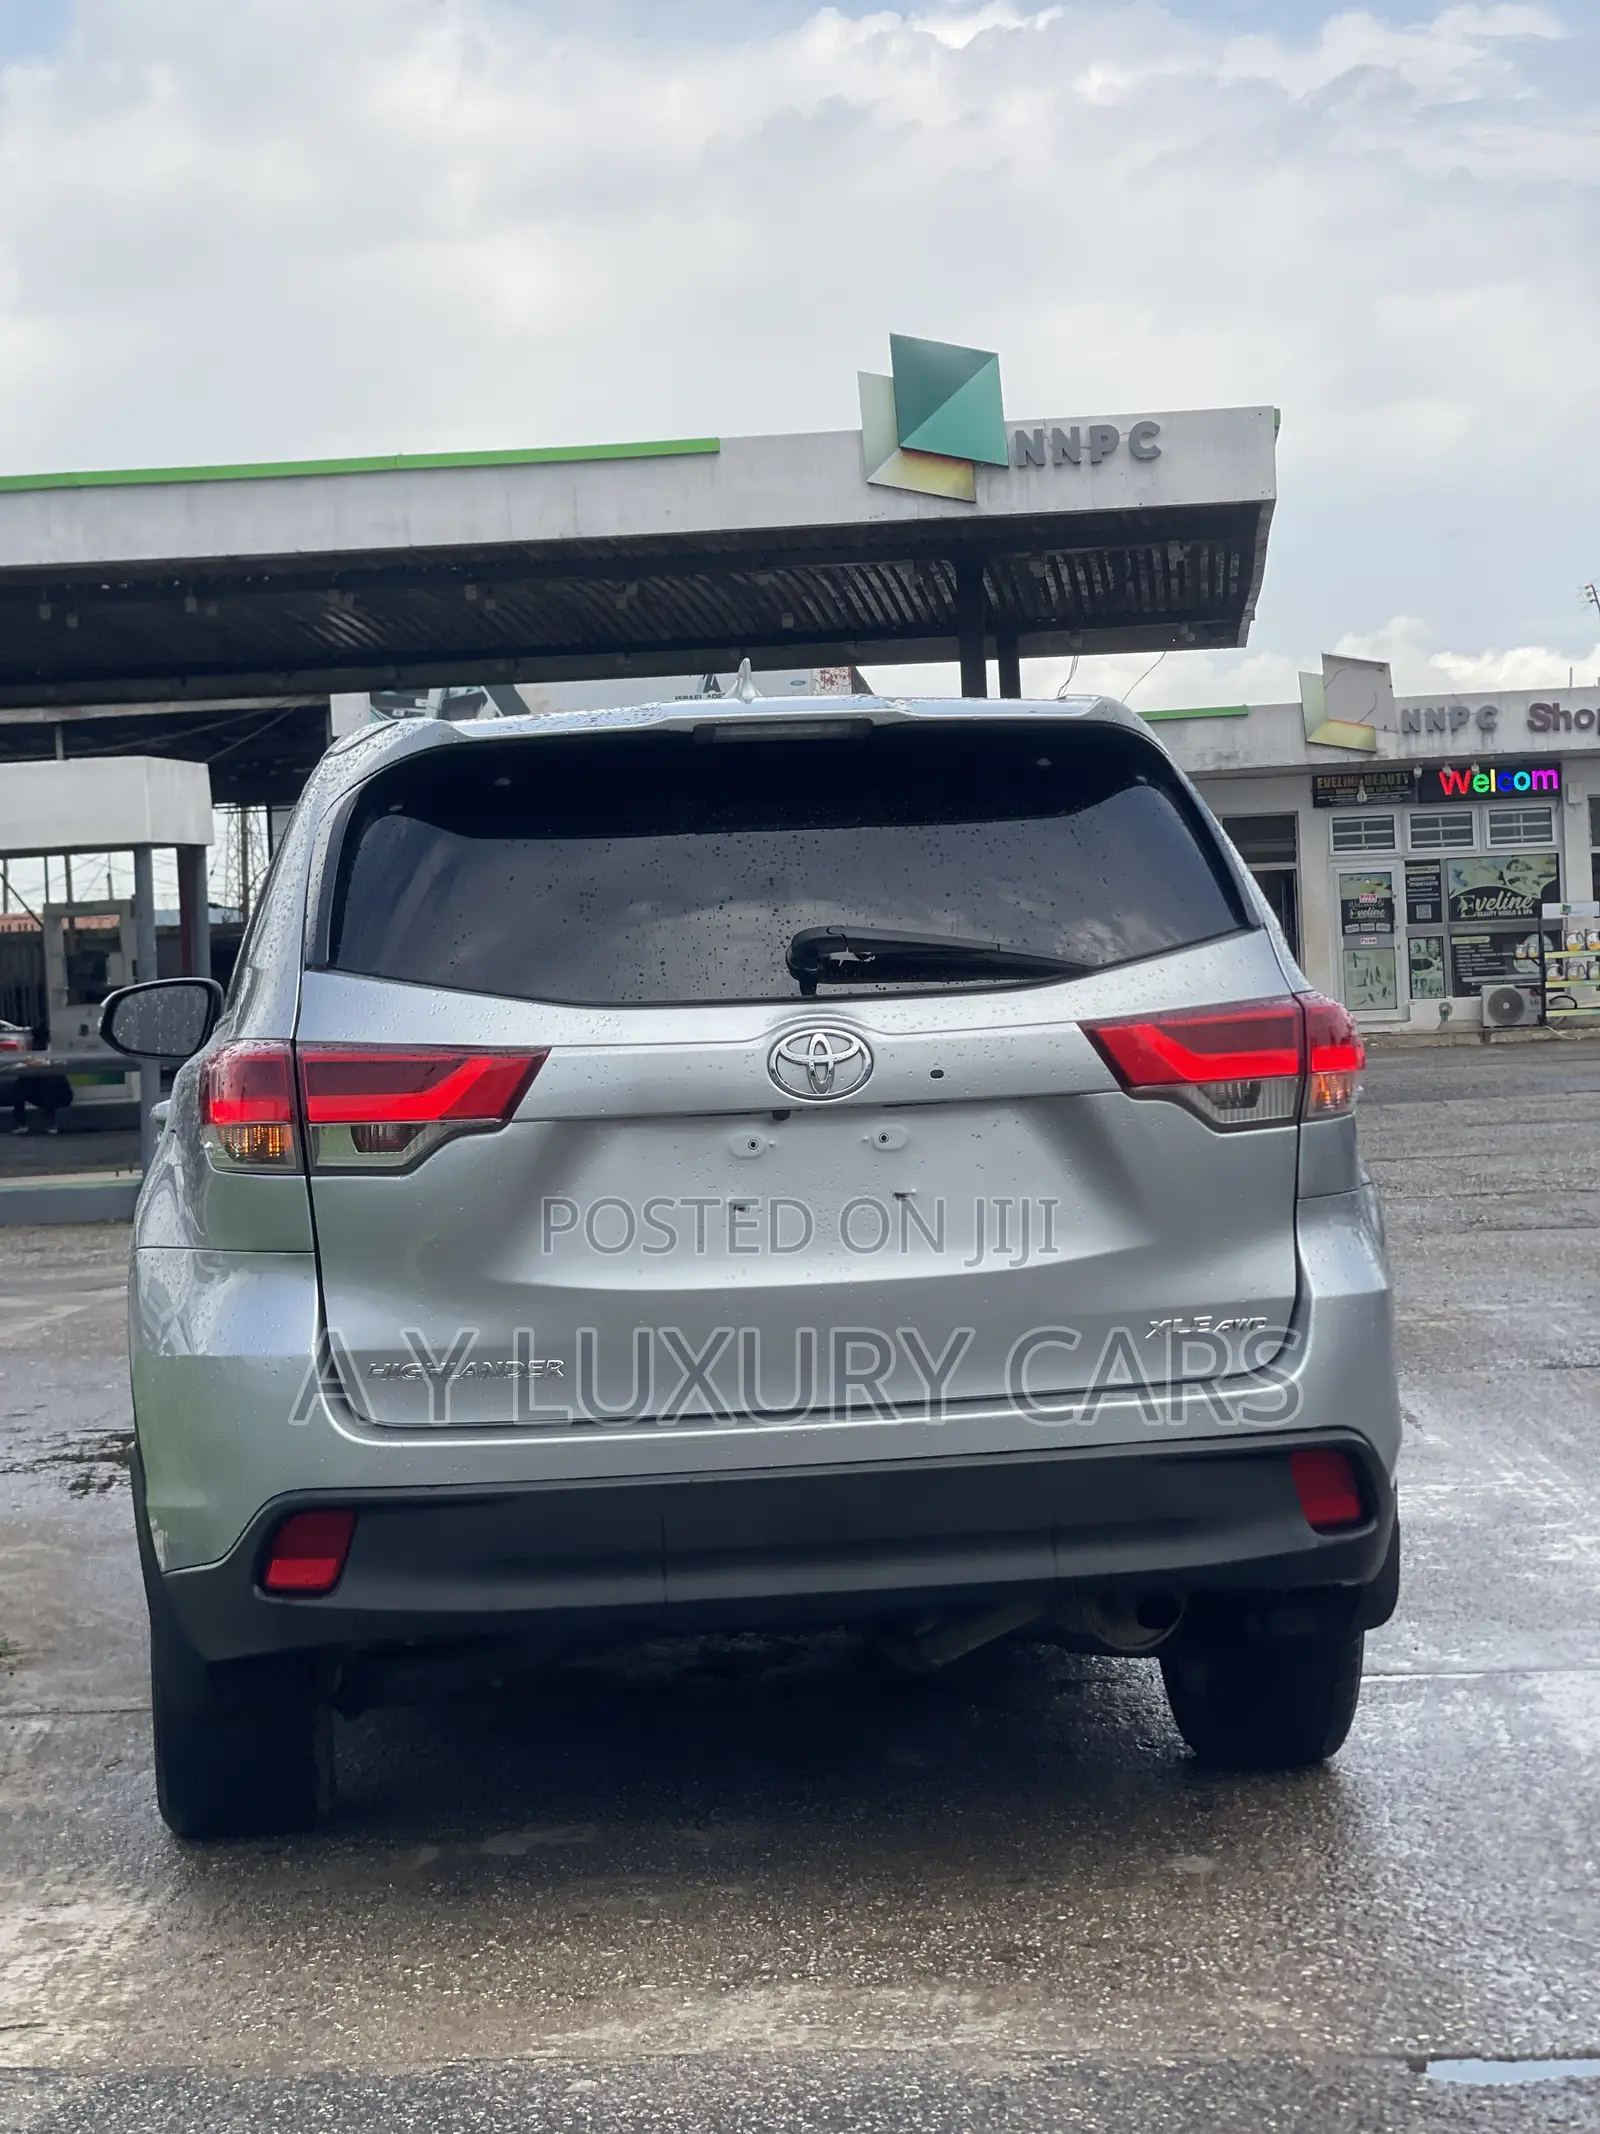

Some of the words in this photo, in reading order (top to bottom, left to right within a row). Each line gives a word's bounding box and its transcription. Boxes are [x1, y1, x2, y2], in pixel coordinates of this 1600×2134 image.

[1014, 420, 1162, 467] NNPC
[1401, 705, 1498, 733] NNPC
[1527, 702, 1600, 737] Sho
[1439, 768, 1559, 796] Welcom
[1457, 890, 1534, 918] Eveline
[1145, 1315, 1212, 1339] XLE
[367, 1359, 565, 1381] HIGHLANDER
